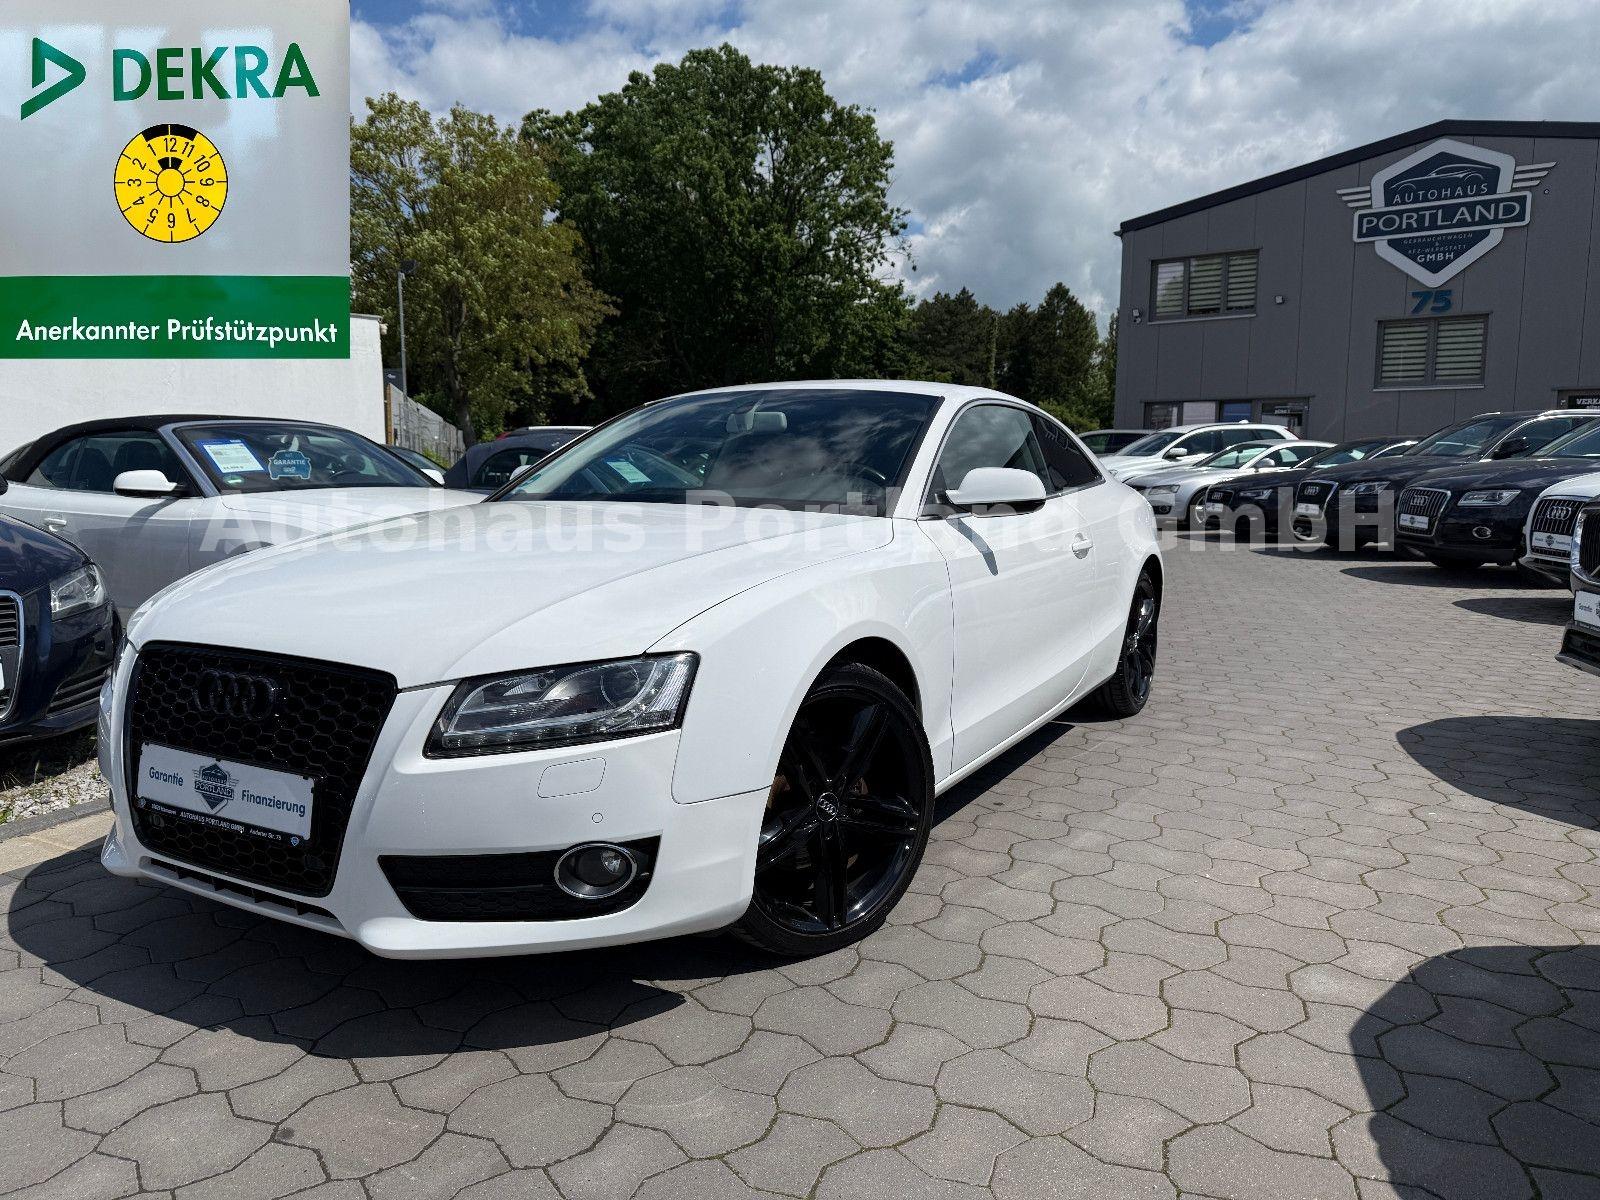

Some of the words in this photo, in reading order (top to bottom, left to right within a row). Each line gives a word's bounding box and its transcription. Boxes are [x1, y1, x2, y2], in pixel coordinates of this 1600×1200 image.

[1392, 183, 1489, 205] AUTOHAUS
[1361, 201, 1521, 234] PORTLAND
[1416, 251, 1455, 263] GMBH
[1410, 289, 1453, 314] 75
[149, 766, 184, 787] Garantie
[195, 780, 233, 797] PORTLAND
[241, 789, 306, 818] Finanzierung
[180, 811, 205, 823] AUTOHAUS
